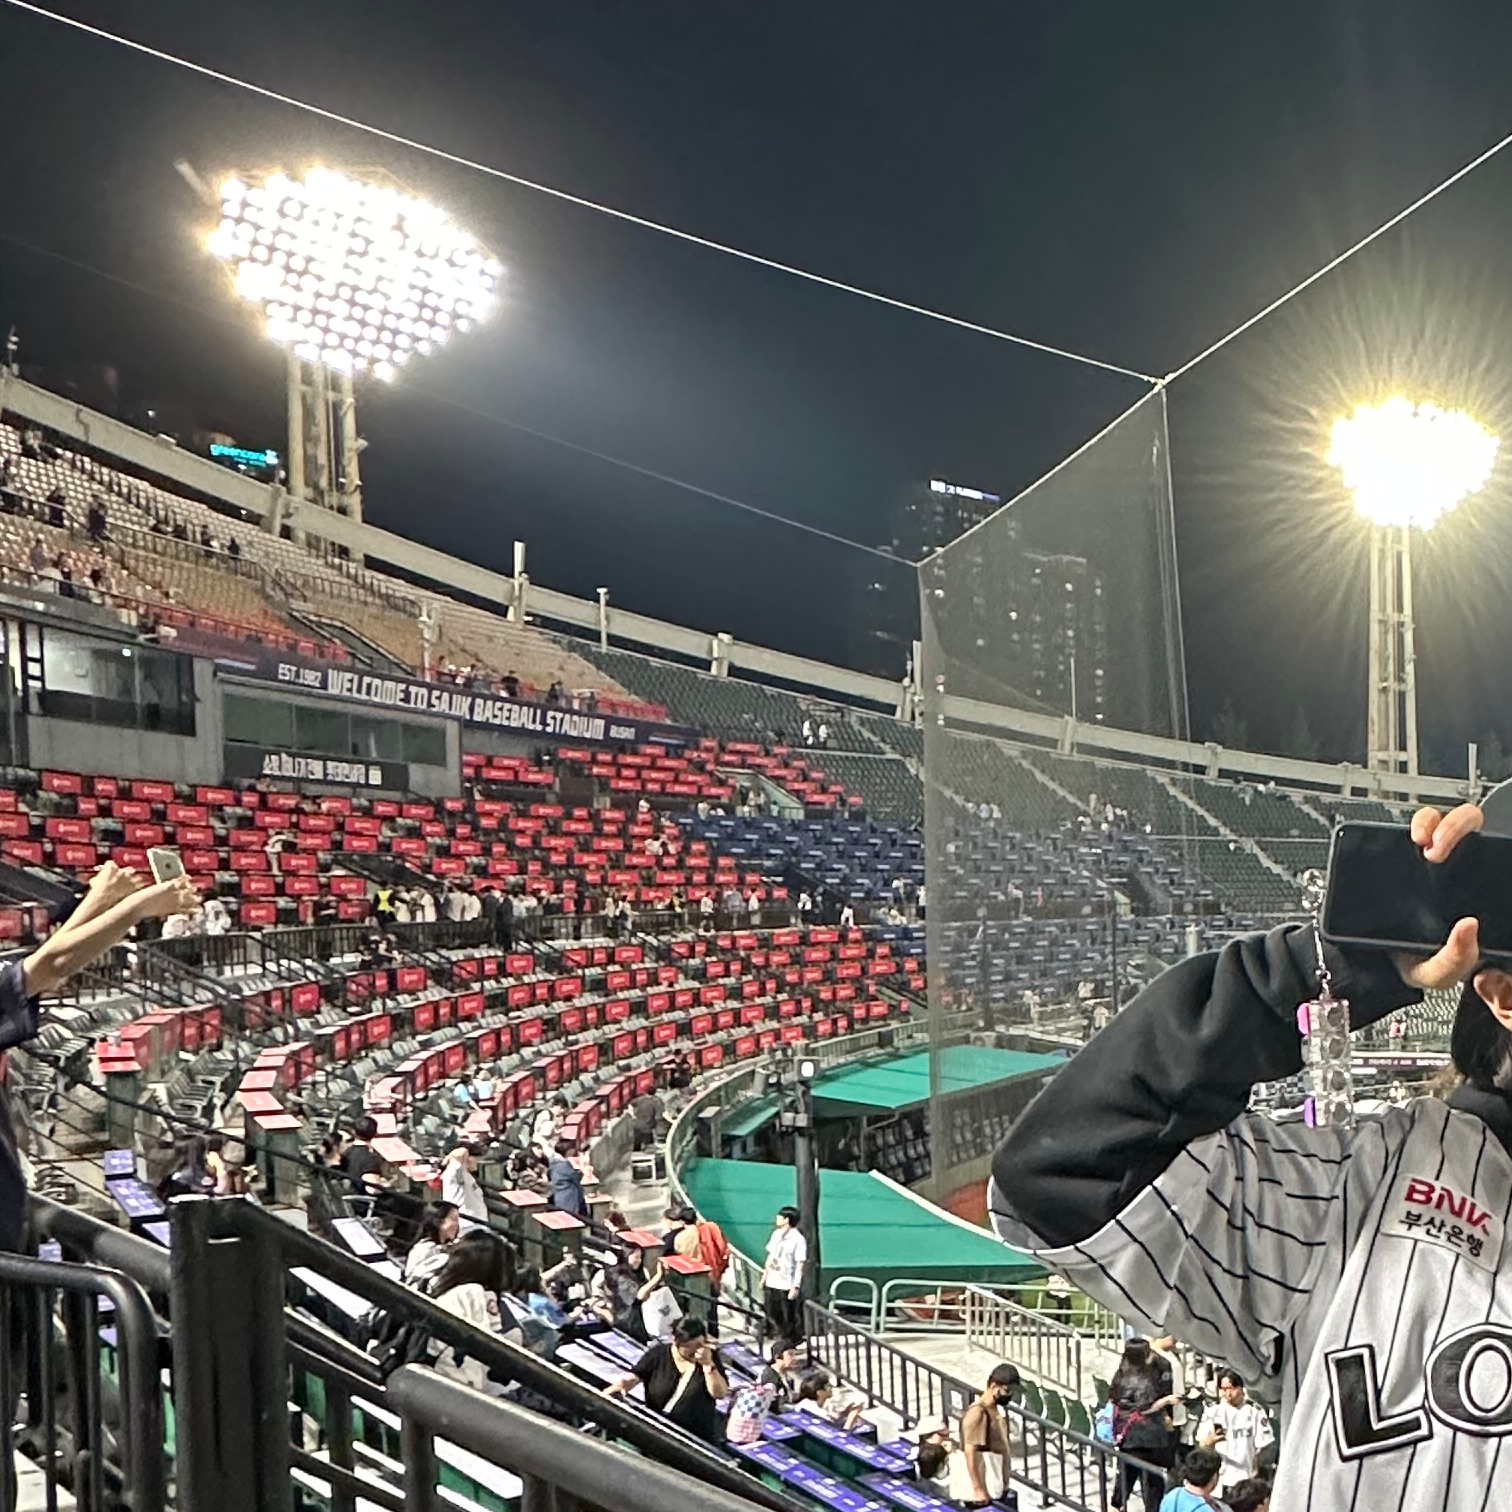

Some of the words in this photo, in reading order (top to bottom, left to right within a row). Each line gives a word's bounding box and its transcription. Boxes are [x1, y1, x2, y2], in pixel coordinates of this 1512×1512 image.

[327, 668, 405, 708] WELCOME
[408, 682, 428, 709] TO
[430, 687, 472, 720] SAJIK
[473, 698, 544, 732] BASEBALL
[545, 711, 606, 740] STADIUM
[1399, 1210, 1484, 1257] 부산은행
[1404, 1177, 1493, 1237] BNK
